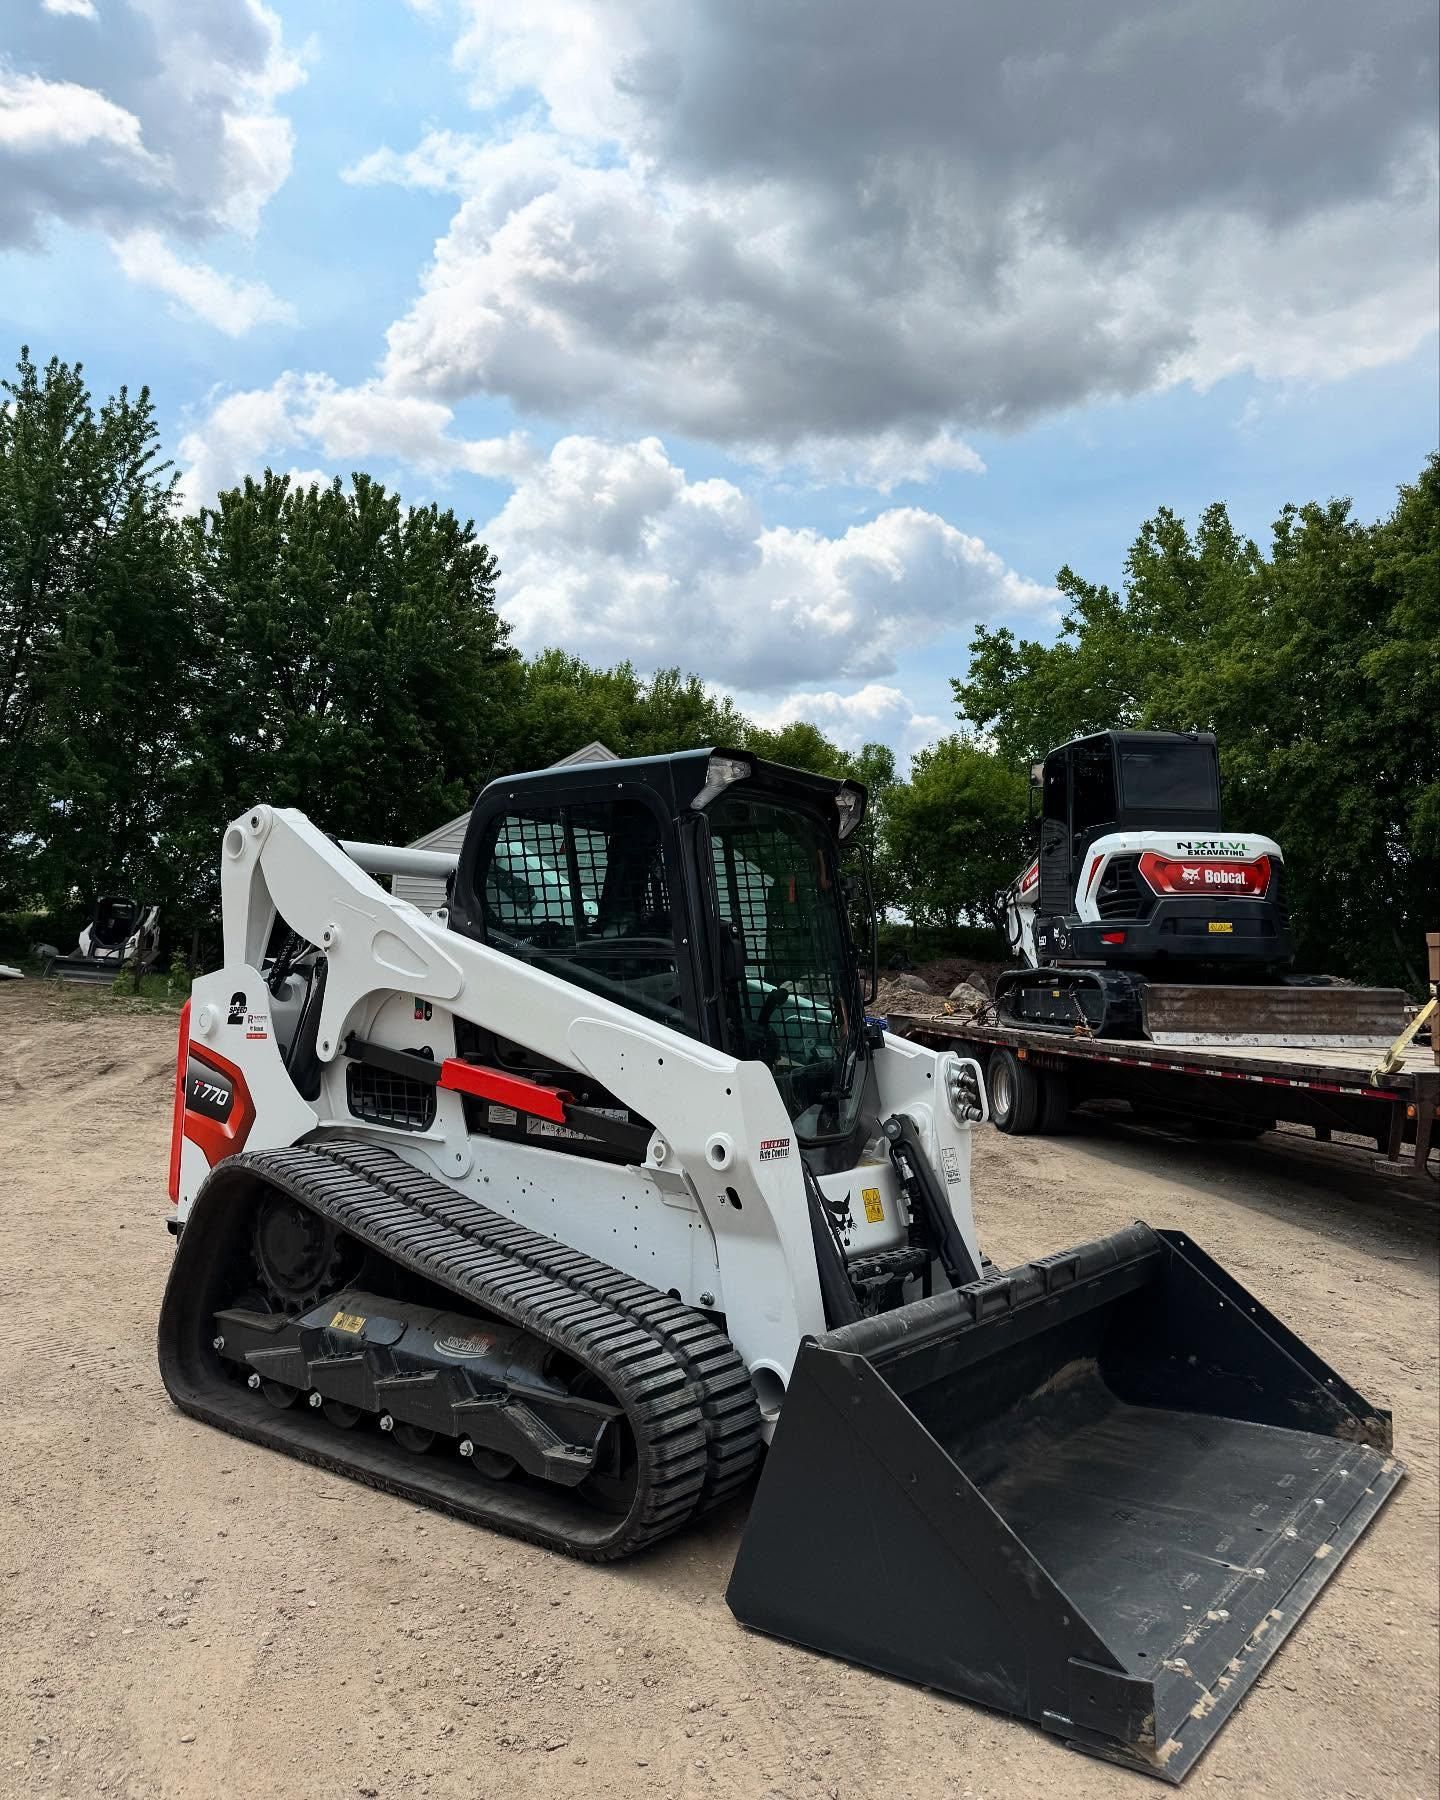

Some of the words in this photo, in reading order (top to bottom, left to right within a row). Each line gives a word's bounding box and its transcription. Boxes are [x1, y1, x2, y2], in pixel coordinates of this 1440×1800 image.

[1205, 869, 1246, 885] Bobcat
[229, 1006, 248, 1014] SPEED
[194, 1080, 229, 1106] T770
